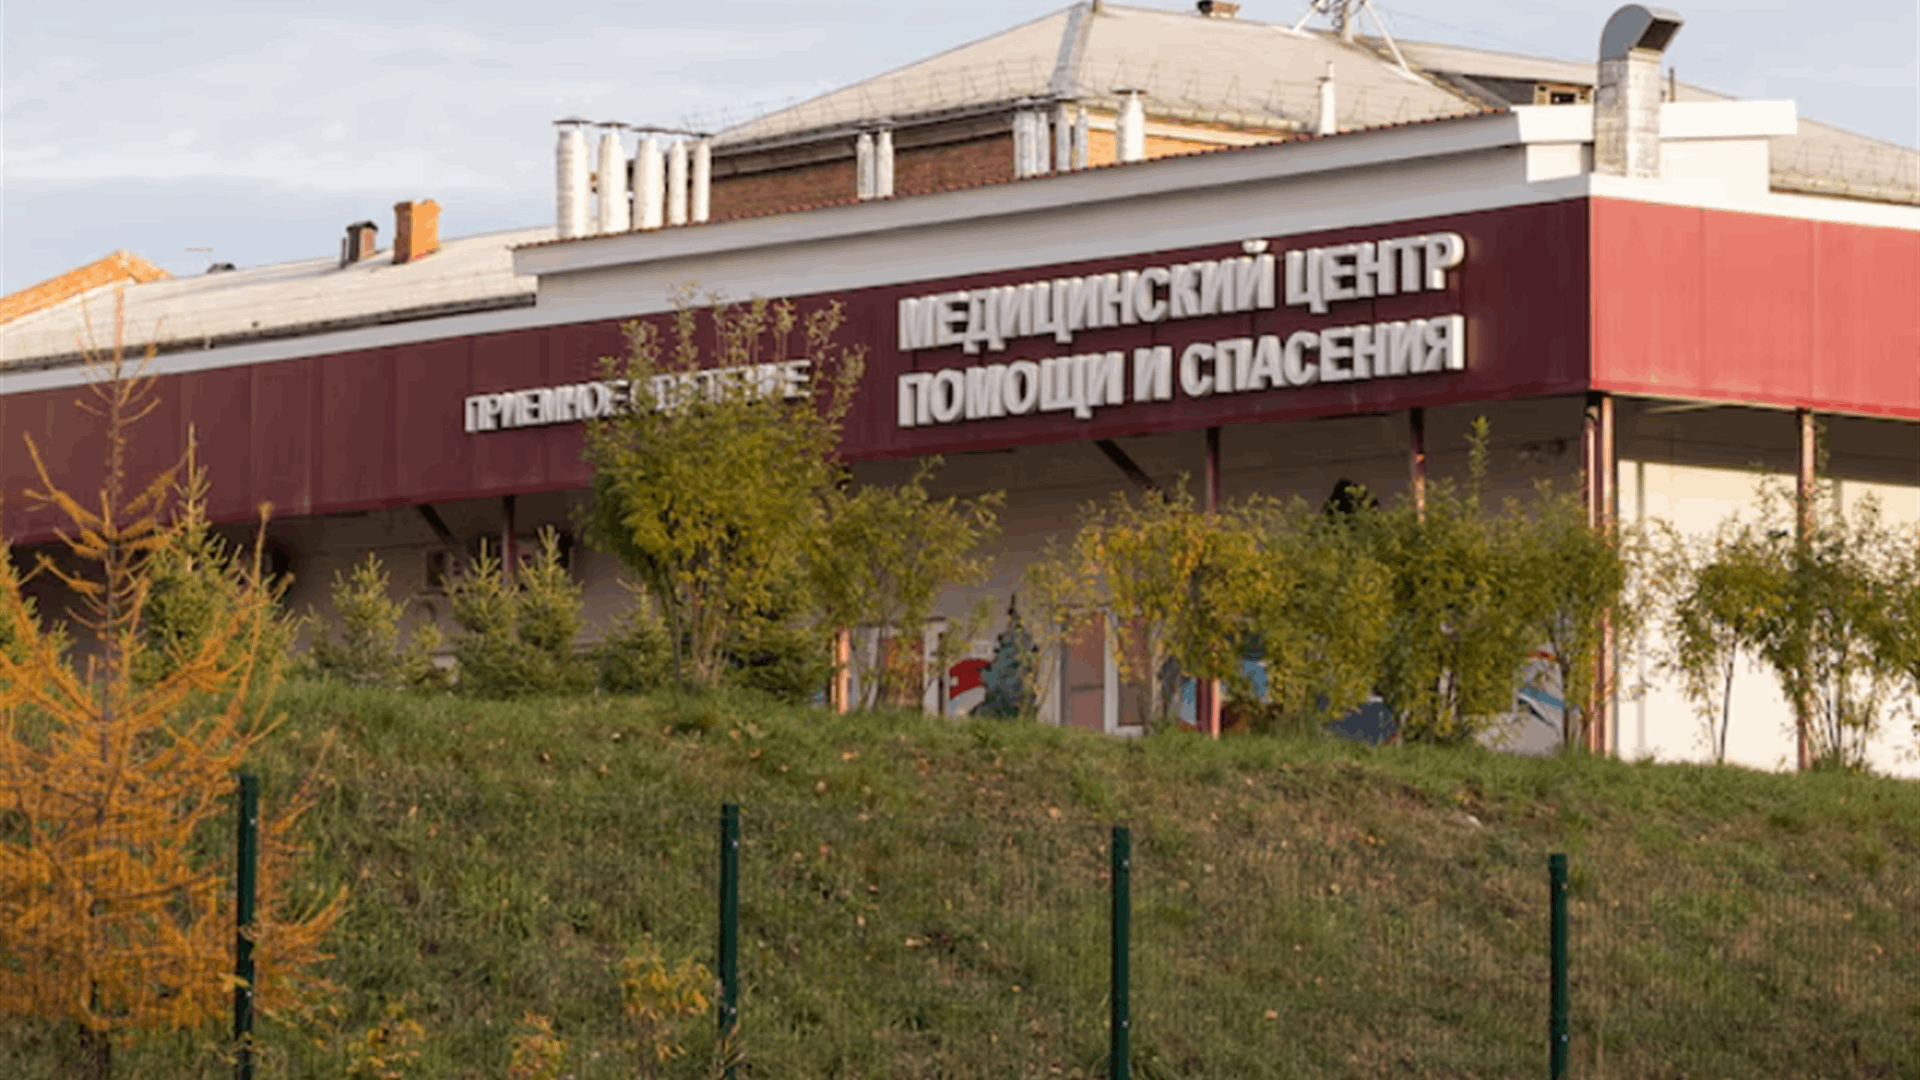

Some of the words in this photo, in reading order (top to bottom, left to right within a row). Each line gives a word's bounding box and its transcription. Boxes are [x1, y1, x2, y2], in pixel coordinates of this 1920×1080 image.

[898, 239, 1276, 353] МЕДИЦИНСКИЙ
[1285, 232, 1466, 314] ЦЕНТР
[464, 378, 629, 433] ПРИЕМНОЕ
[898, 351, 1125, 428] ПОМОЩИ
[1133, 345, 1173, 402] И
[1180, 314, 1466, 397] СПАСЕНИЯ
